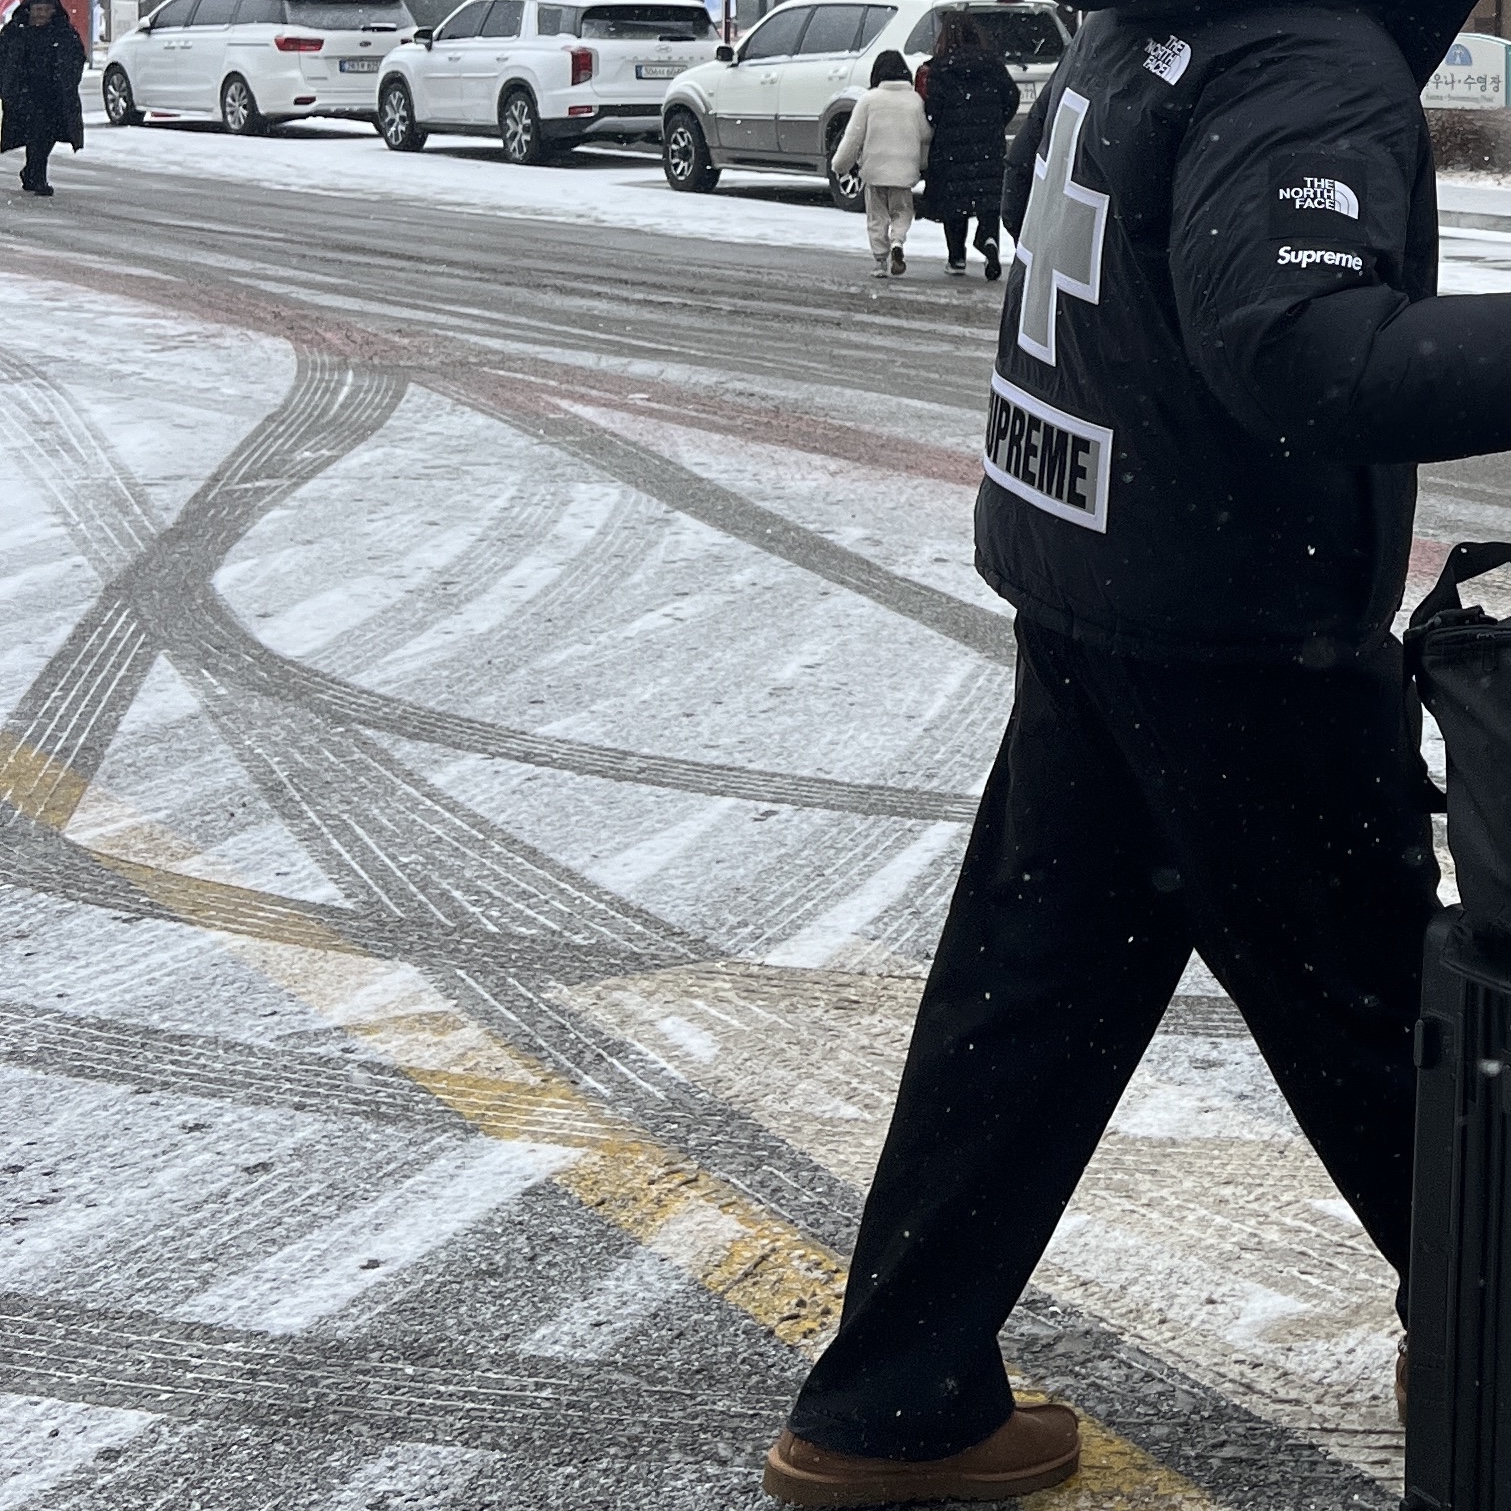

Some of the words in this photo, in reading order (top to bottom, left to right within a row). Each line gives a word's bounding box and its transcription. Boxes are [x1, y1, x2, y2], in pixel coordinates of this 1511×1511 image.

[1144, 38, 1178, 67] NORTH
[1165, 35, 1186, 57] THE
[1143, 55, 1171, 78] FACE
[1425, 73, 1503, 93] 우나·수영장
[1279, 188, 1335, 200] NORTH
[1303, 177, 1335, 190] THE
[1295, 198, 1335, 210] FACE
[1277, 246, 1363, 271] Supreme
[986, 388, 1091, 510] UPREME
